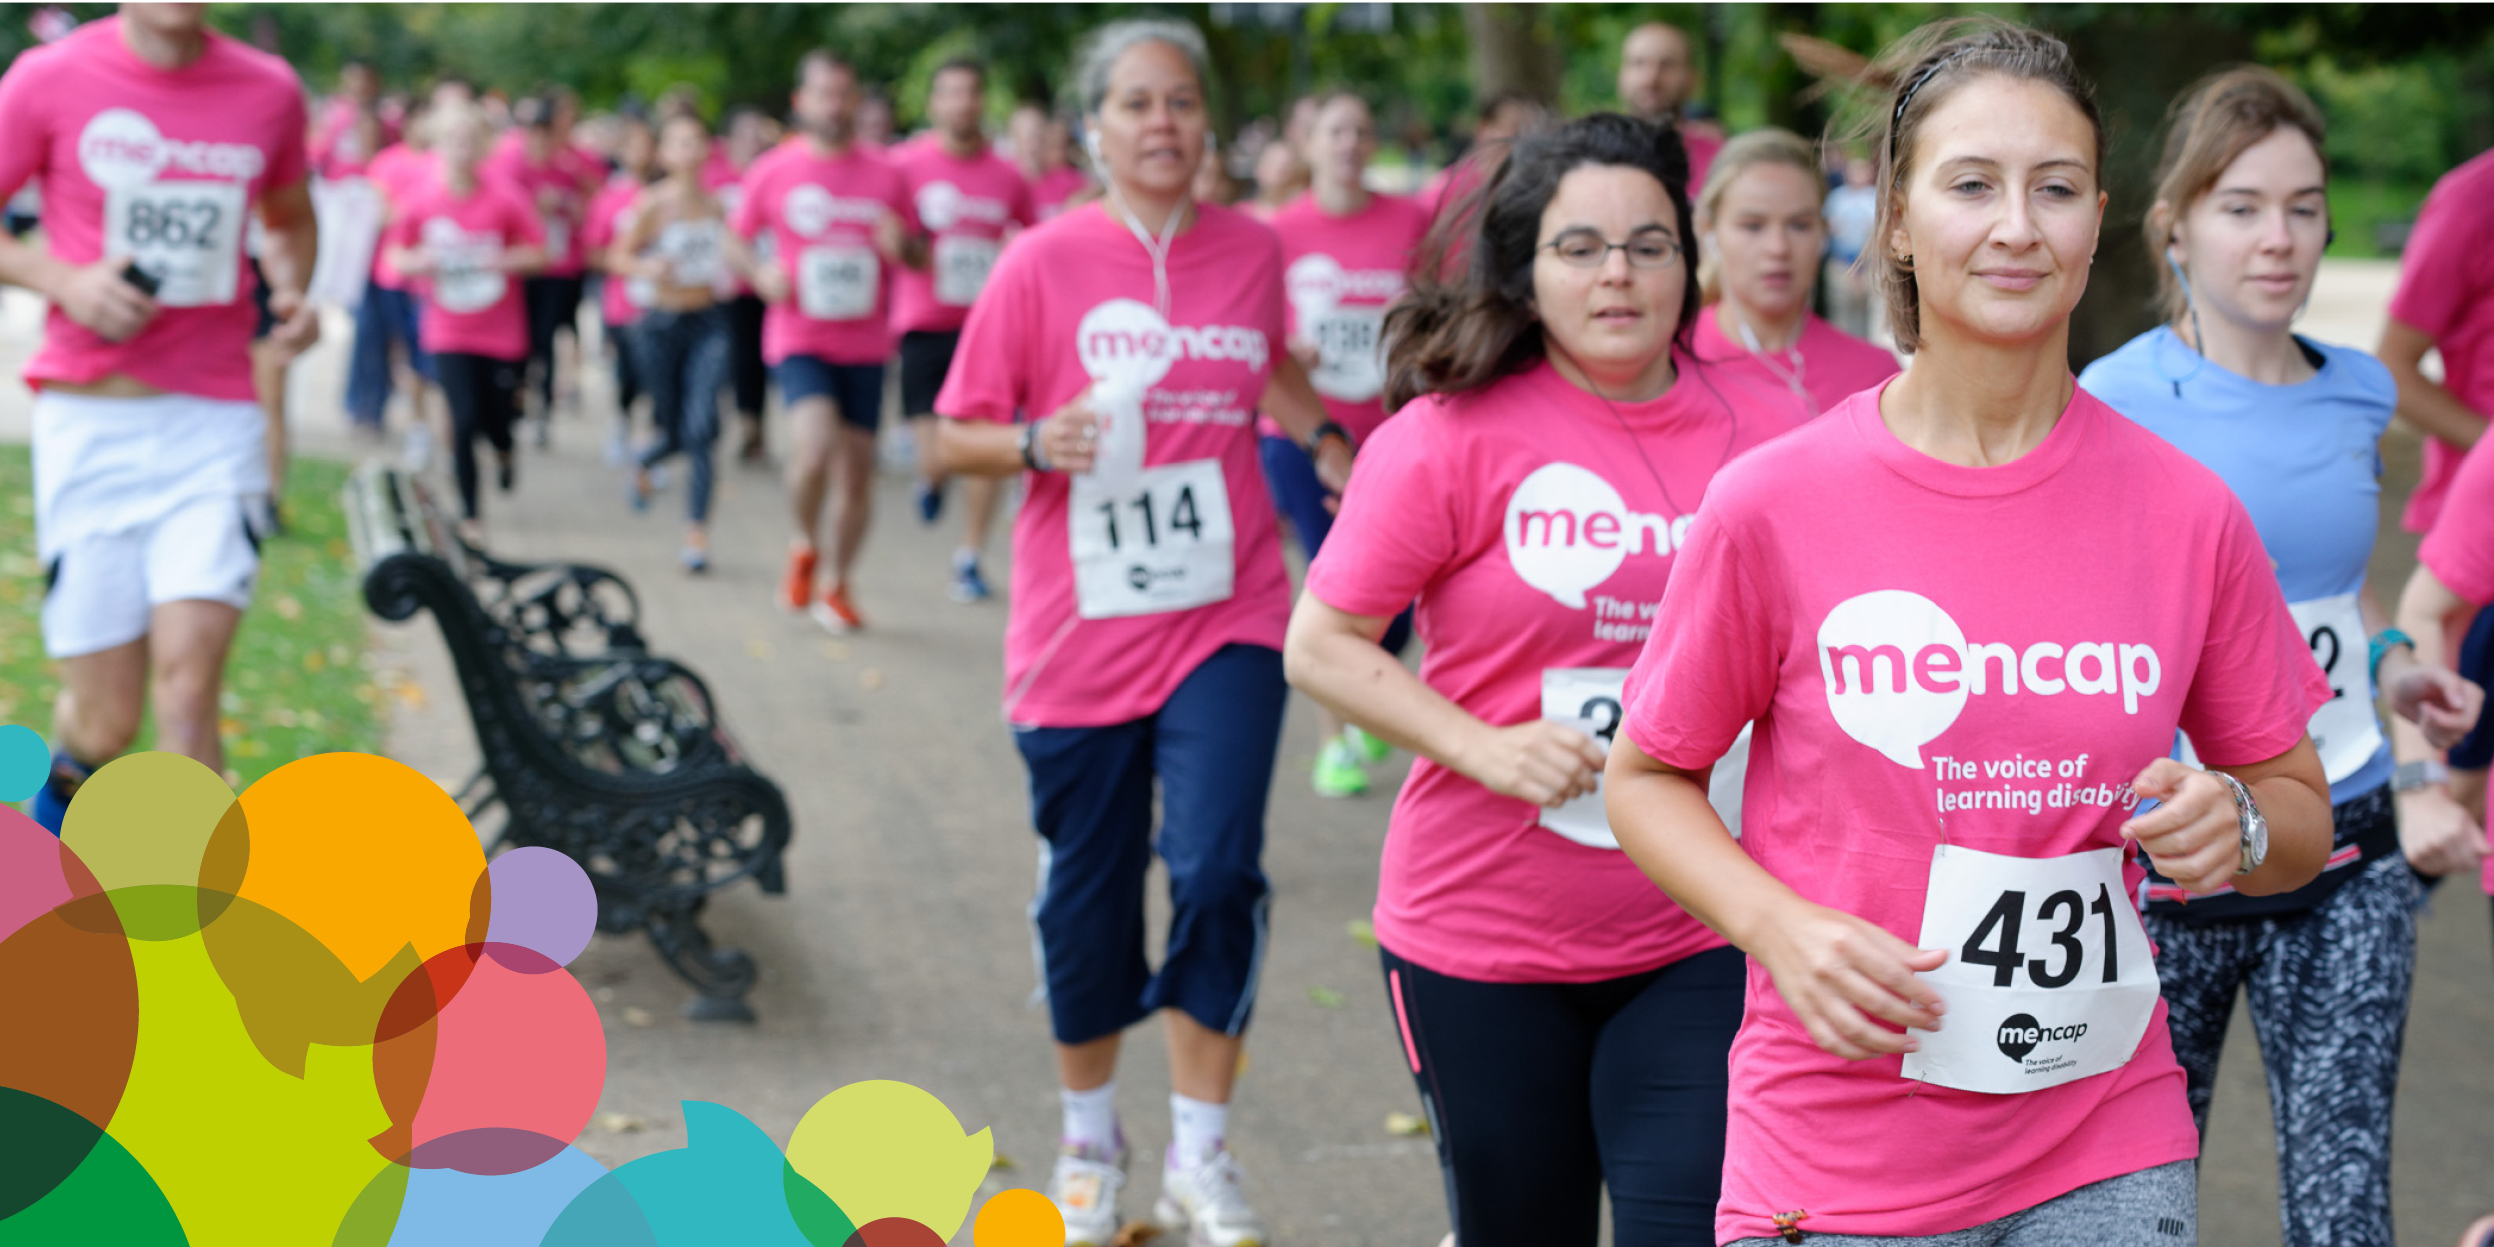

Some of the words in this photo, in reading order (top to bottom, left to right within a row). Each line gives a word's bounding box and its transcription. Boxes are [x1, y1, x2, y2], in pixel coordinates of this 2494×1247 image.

[127, 198, 220, 248] 862
[1089, 324, 1269, 373] mencap
[1097, 486, 1201, 548] 114
[1593, 596, 1635, 620] The
[1827, 641, 2161, 715] mencap
[1931, 756, 1977, 780] The
[1983, 754, 2052, 779] voice
[2058, 754, 2088, 778] of
[1936, 788, 2042, 815] learning
[2047, 783, 2141, 812] disabiity
[1960, 882, 2118, 989] 431
[1999, 1022, 2088, 1044] mencap
[2024, 1063, 2051, 1075] learning
[2025, 1058, 2038, 1066] The
[2039, 1057, 2055, 1066] voice
